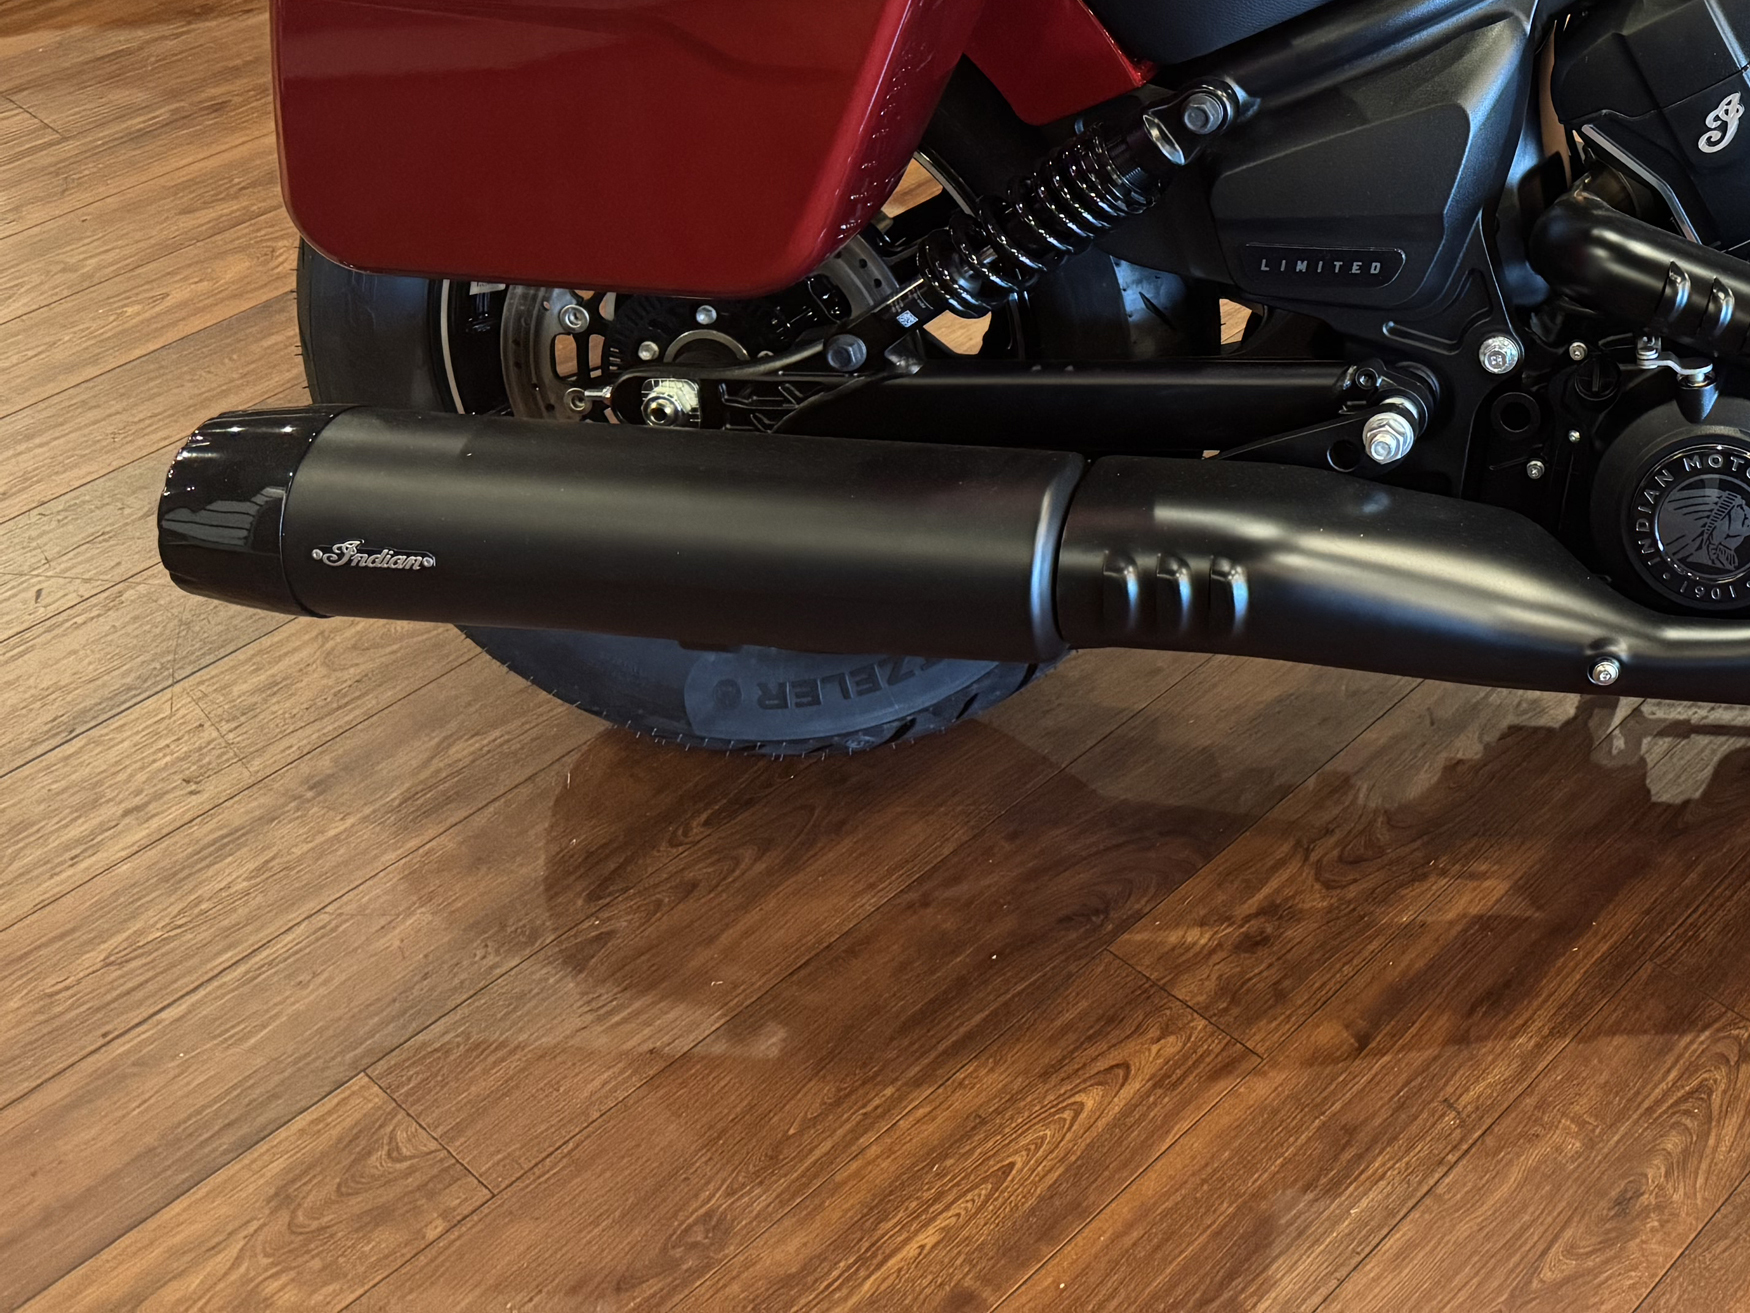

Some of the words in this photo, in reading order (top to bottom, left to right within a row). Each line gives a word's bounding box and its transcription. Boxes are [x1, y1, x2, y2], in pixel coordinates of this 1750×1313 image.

[1260, 258, 1382, 275] LIMITED
[1635, 468, 1675, 566] INDIAN
[322, 539, 423, 571] Indian
[1679, 580, 1737, 601] 1901
